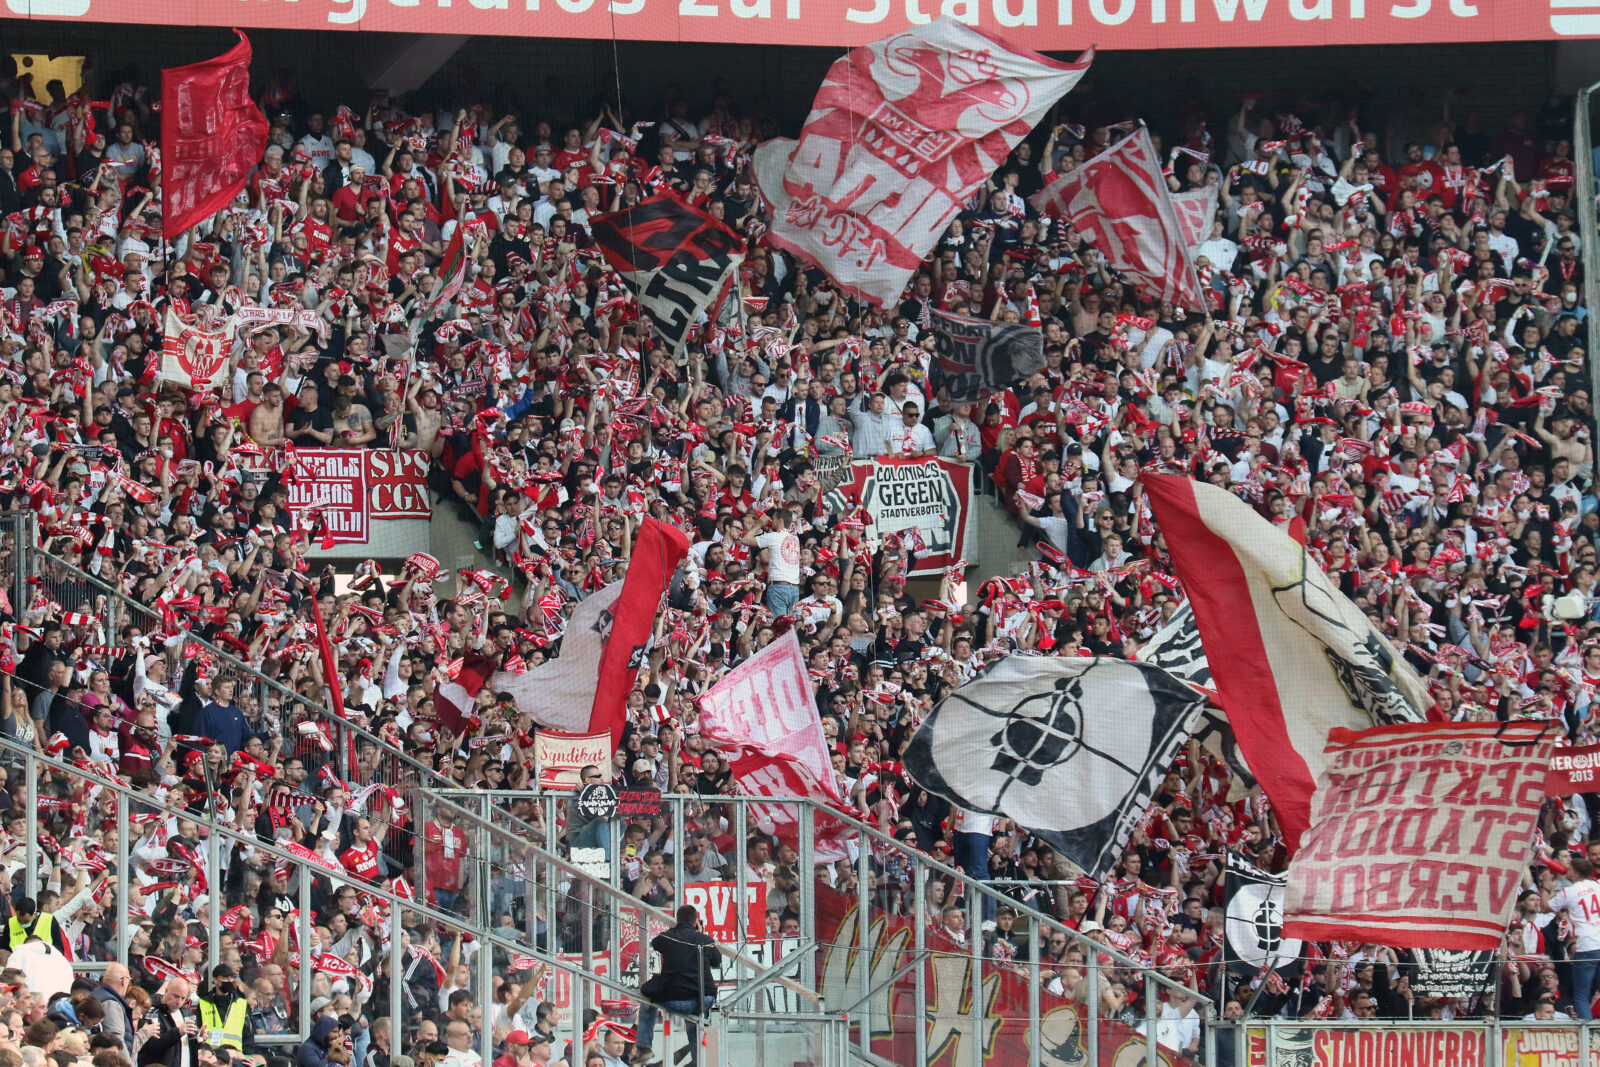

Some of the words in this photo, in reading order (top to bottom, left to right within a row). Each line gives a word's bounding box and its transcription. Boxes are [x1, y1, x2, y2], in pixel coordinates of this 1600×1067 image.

[370, 450, 432, 478] SPS
[876, 463, 940, 482] COLONIACS
[879, 479, 943, 506] GEGEN
[880, 504, 943, 519] STADTVERBOTE!
[540, 745, 606, 766] Syndikat
[1569, 770, 1594, 783] 2013
[356, 857, 378, 874] REWE
[1313, 1029, 1509, 1067] STADIONVERB
[1518, 1029, 1578, 1055] Junge
